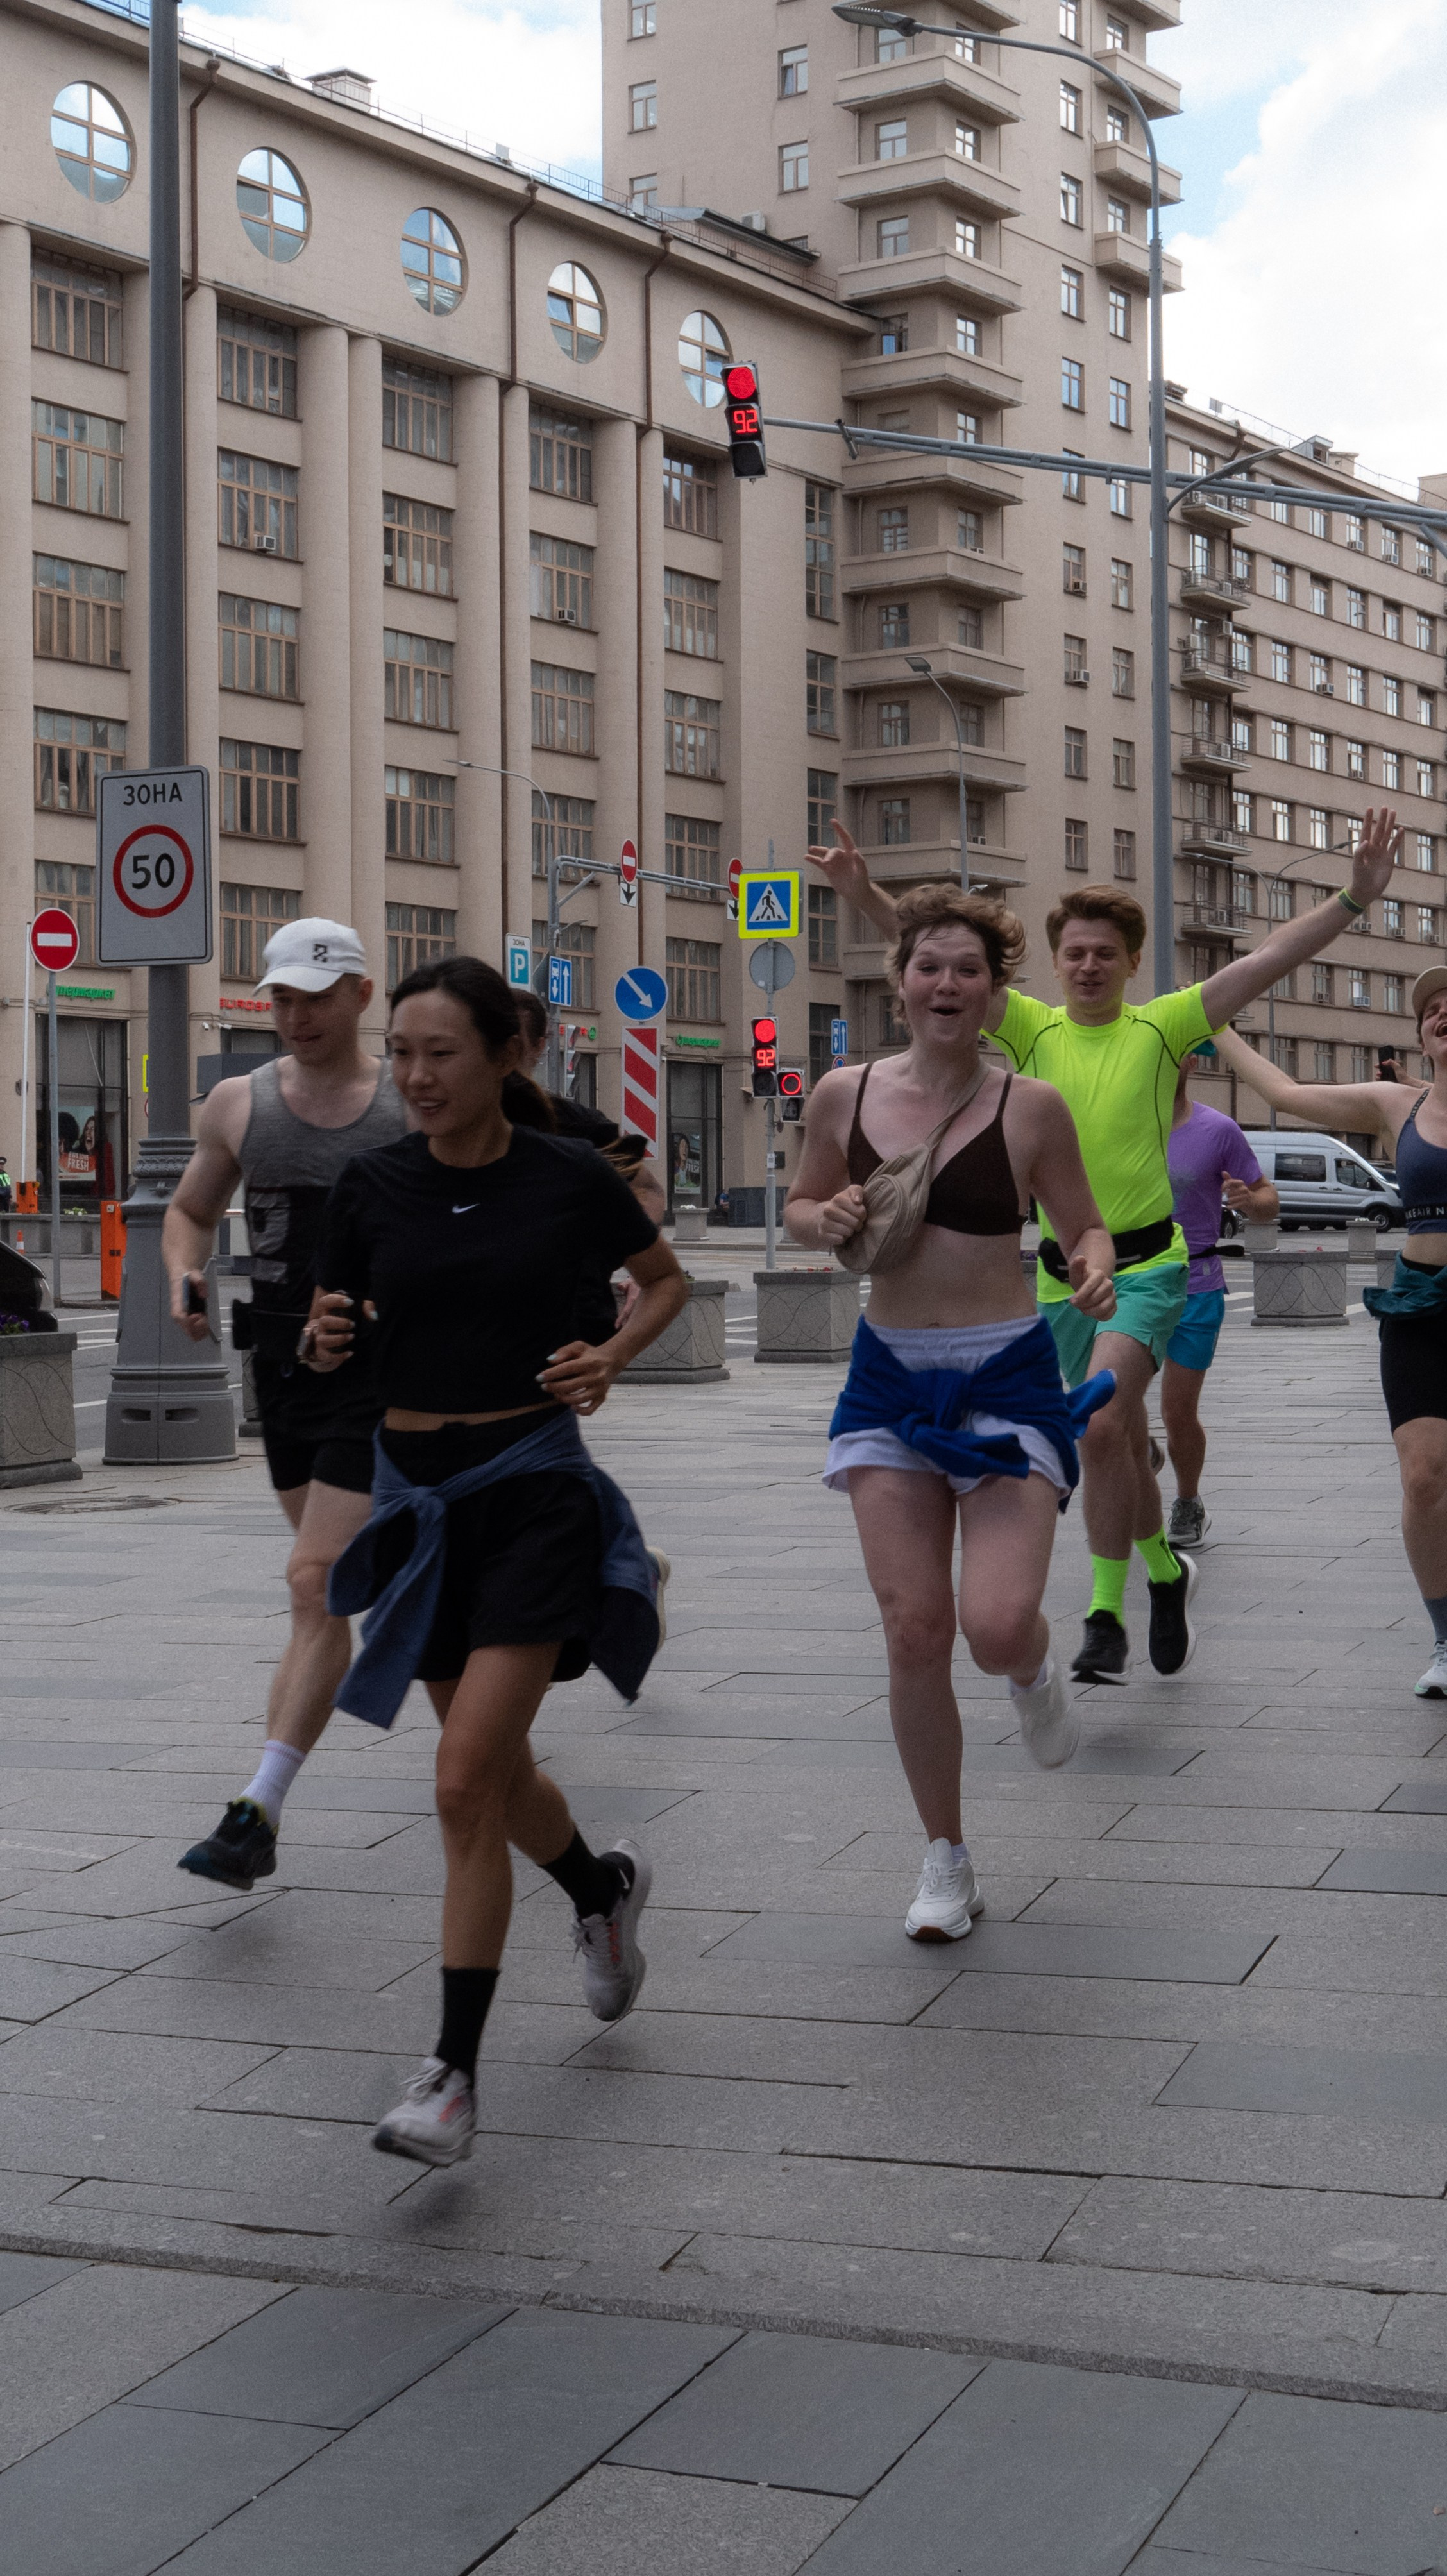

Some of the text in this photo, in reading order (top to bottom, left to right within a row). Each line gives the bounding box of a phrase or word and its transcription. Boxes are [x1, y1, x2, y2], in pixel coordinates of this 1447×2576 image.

[733, 409, 757, 433] 92
[123, 782, 183, 806] ЗОНА
[131, 853, 175, 890] 50
[514, 953, 525, 979] P
[756, 1049, 775, 1067] 92
[67, 1157, 89, 1171] FRESH
[686, 1164, 700, 1174] FRESH
